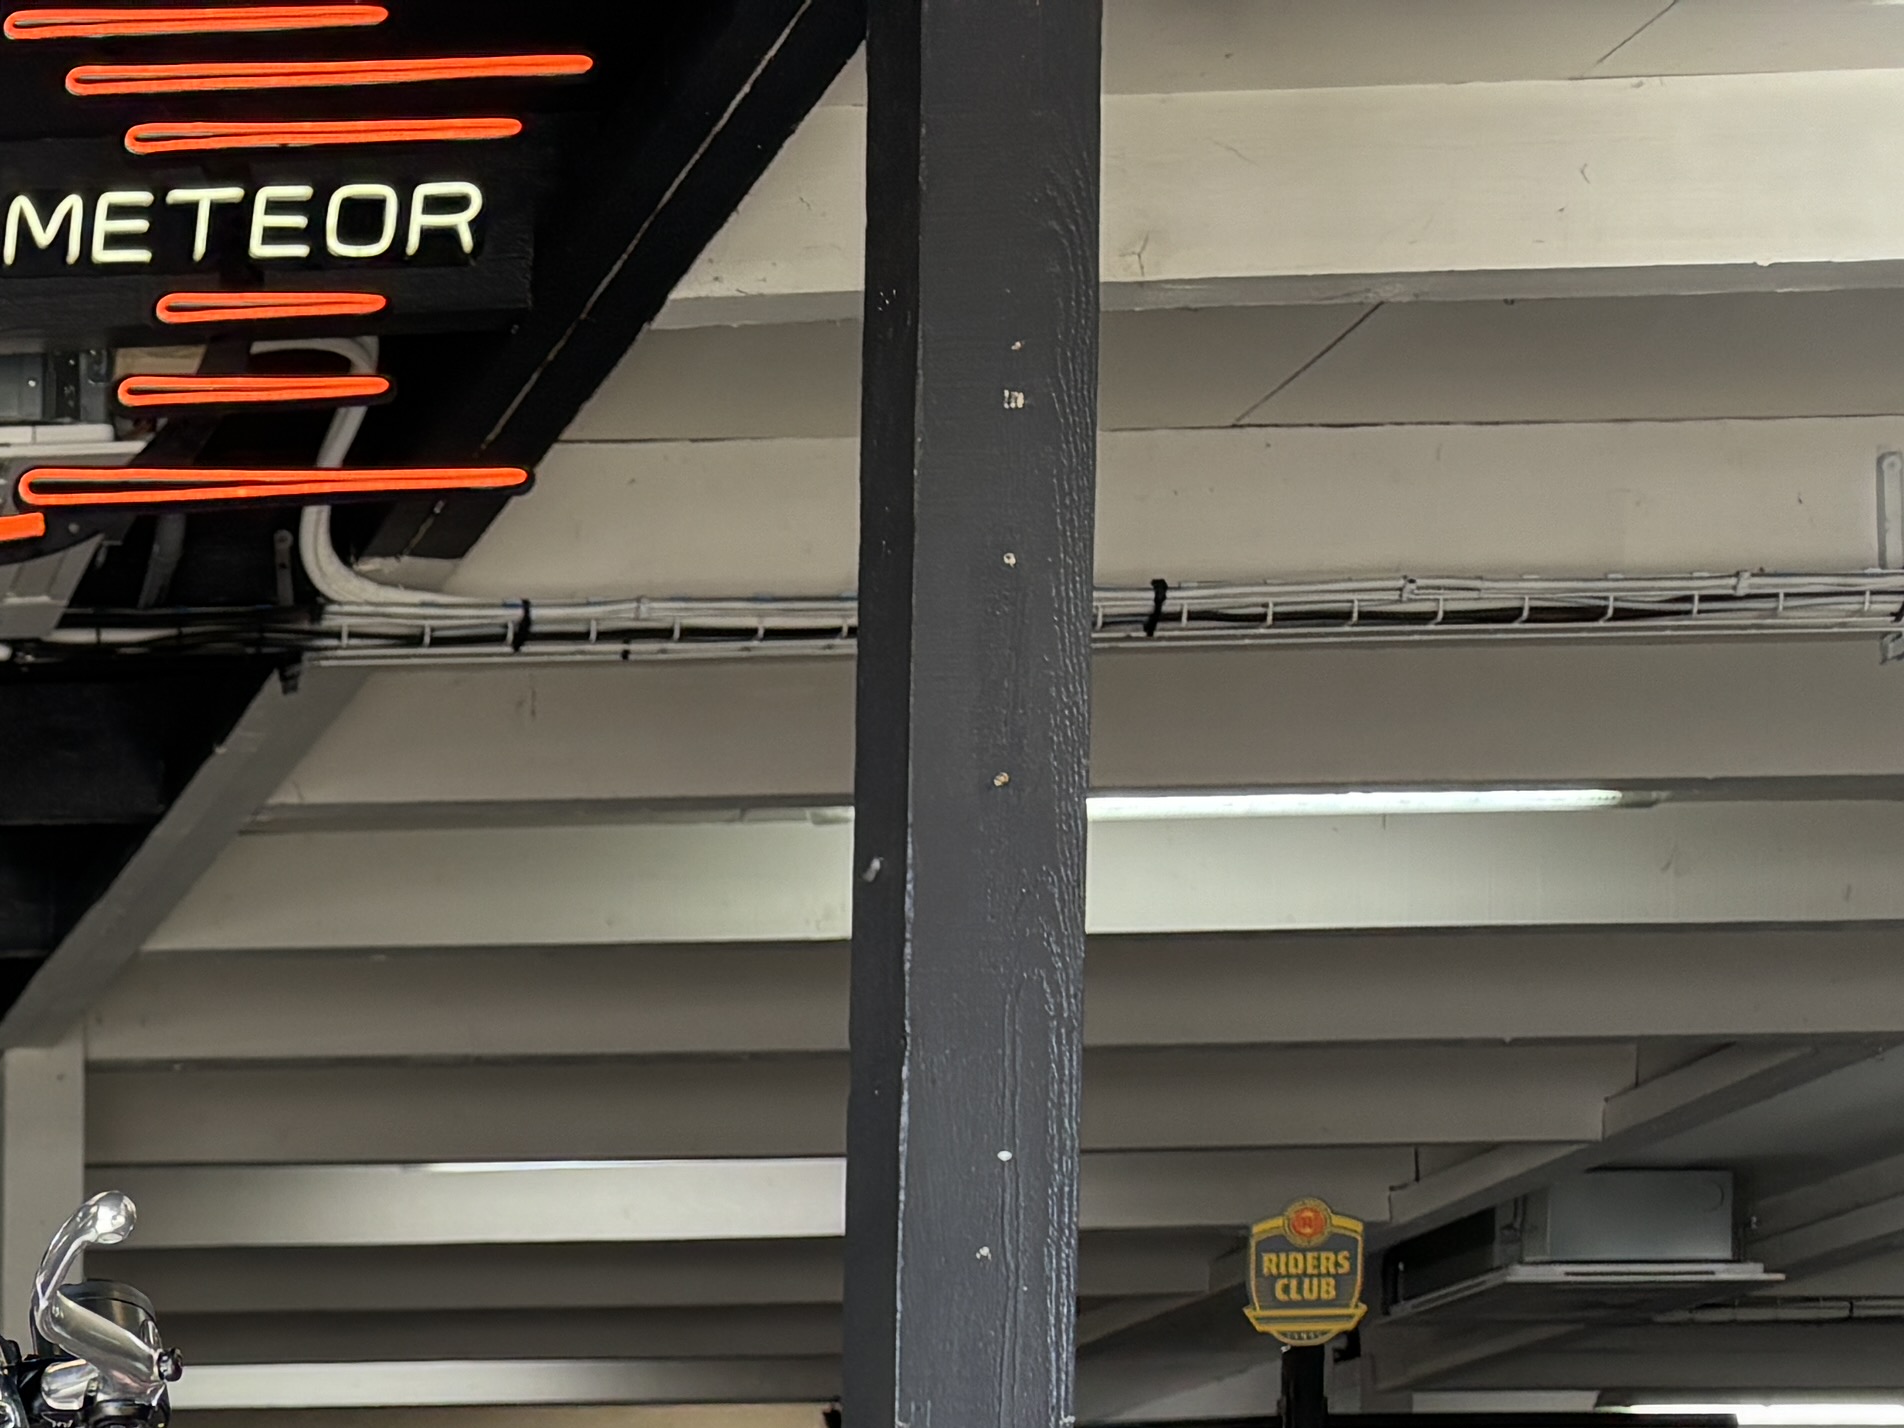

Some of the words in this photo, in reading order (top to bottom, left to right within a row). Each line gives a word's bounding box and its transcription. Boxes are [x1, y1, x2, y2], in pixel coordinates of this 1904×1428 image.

[3, 181, 484, 265] METEOR
[1262, 1252, 1351, 1276] RIDERS
[1275, 1277, 1337, 1301] CLUB
